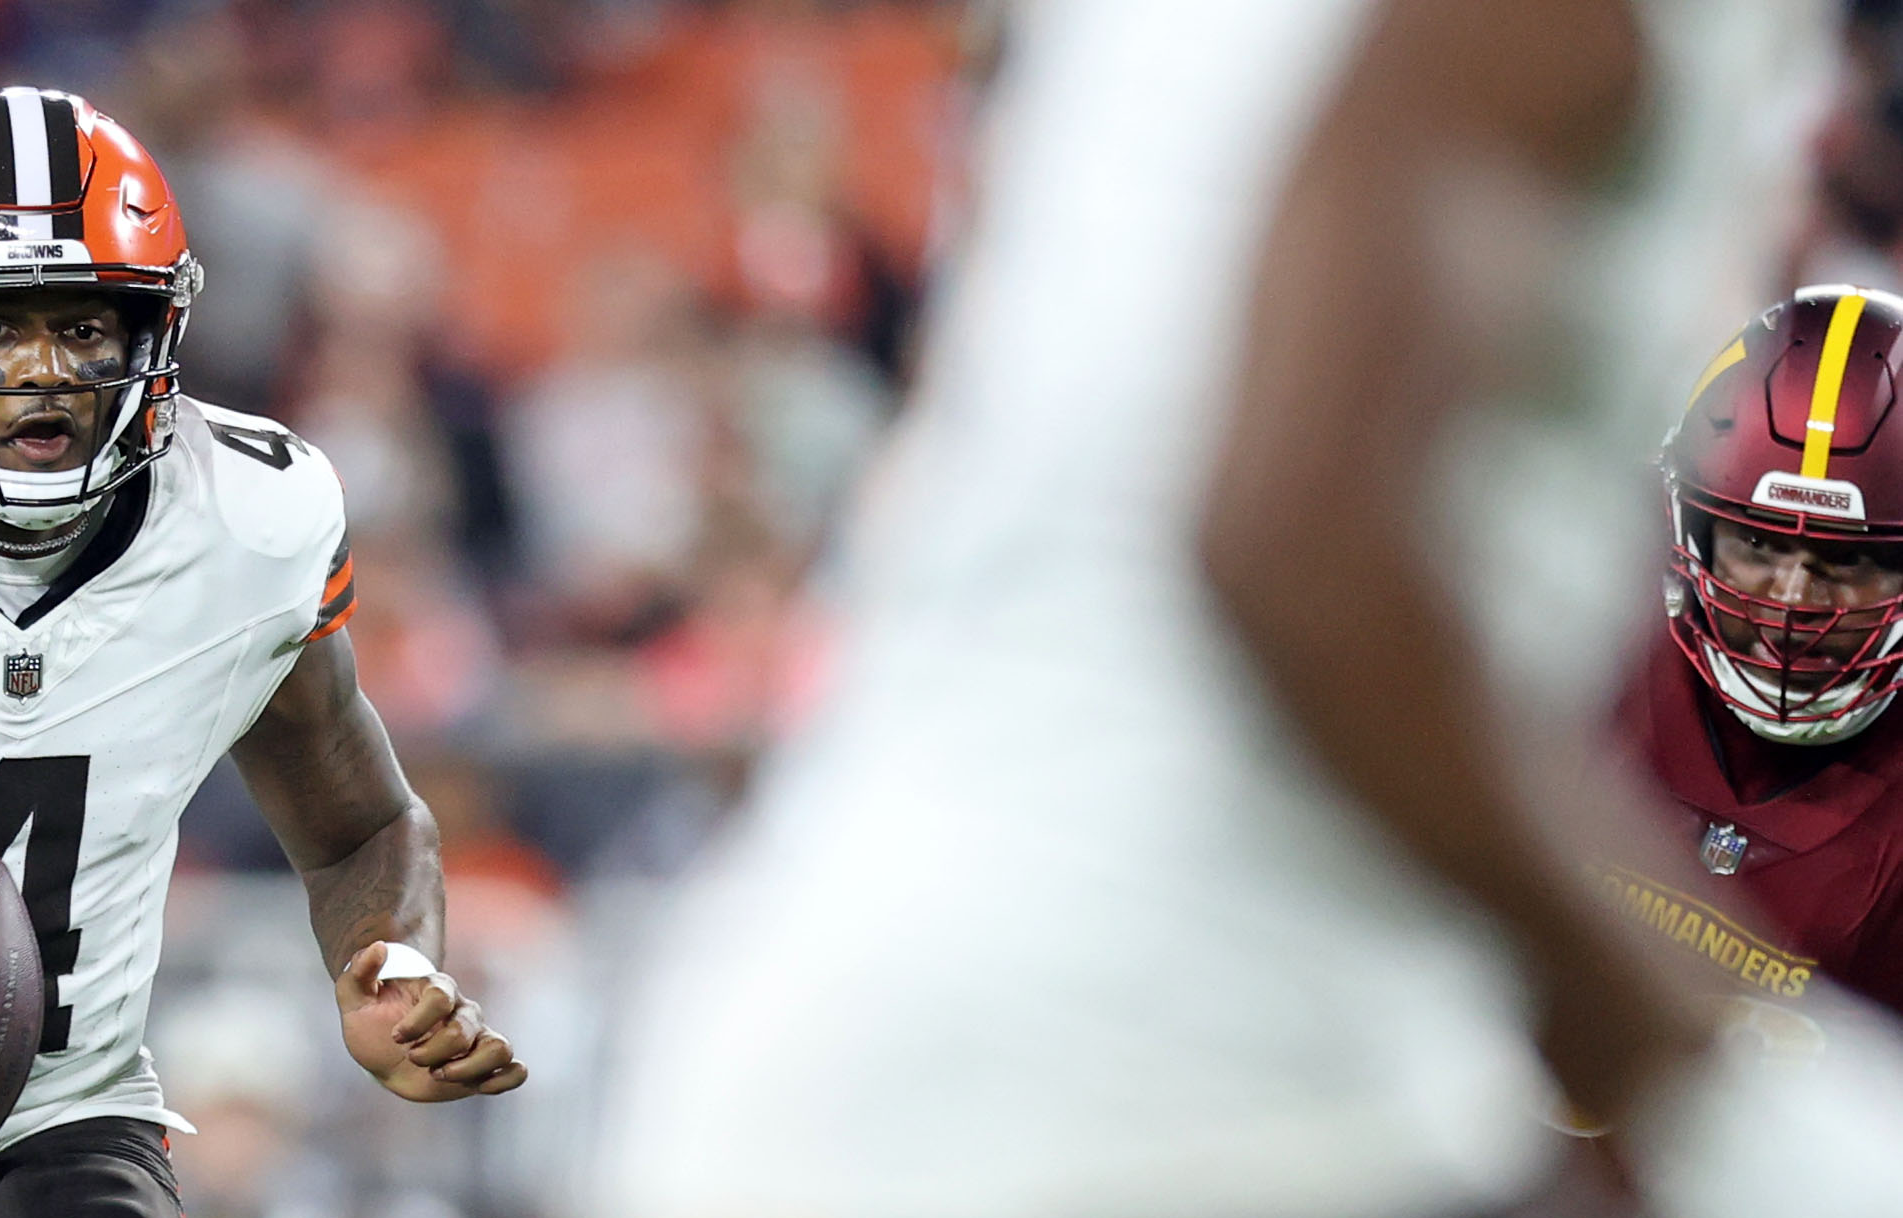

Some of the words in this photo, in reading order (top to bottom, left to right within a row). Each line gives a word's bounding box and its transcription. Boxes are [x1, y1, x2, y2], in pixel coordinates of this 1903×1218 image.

[205, 419, 311, 473] 4
[1767, 484, 1852, 511] COMMANDERS
[1586, 864, 1812, 998] OMMANDERS
